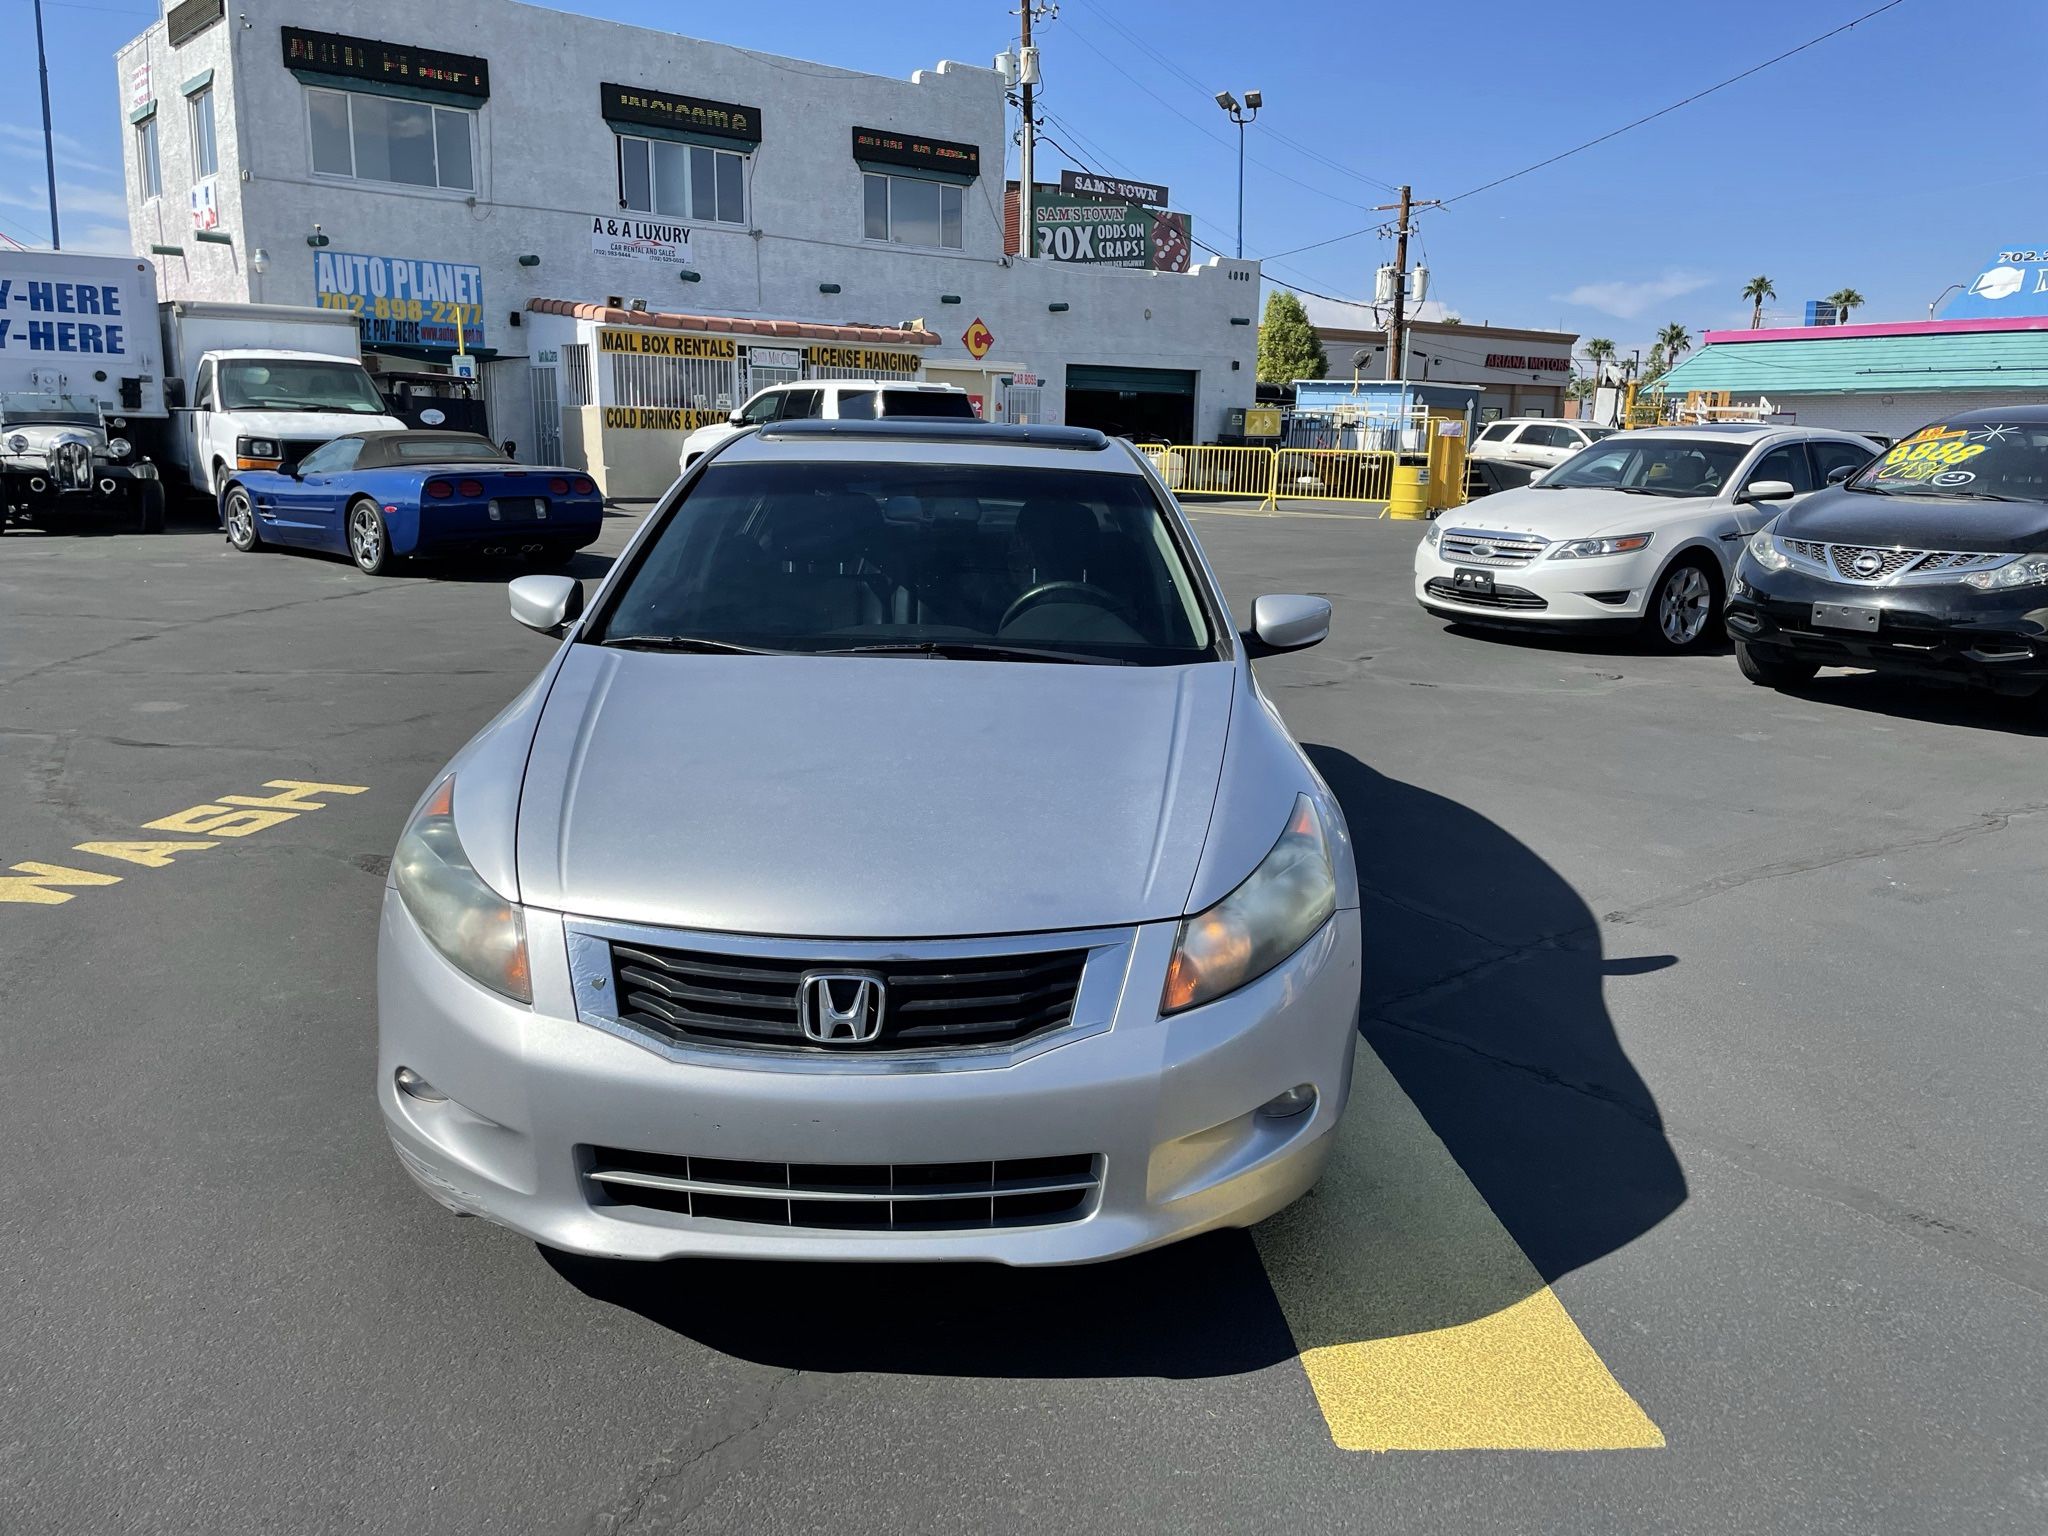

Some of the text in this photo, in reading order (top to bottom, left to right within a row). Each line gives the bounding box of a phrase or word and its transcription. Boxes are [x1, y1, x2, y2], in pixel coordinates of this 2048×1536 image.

[1074, 176, 1158, 201] SAM'S TOWN
[1037, 207, 1126, 222] SAM'S TOWN
[593, 217, 691, 244] A & A LUXURY
[1037, 226, 1095, 260] 20X
[1097, 224, 1145, 239] ODDS ON
[610, 243, 676, 257] CAR RENTAL AND SALES
[1098, 240, 1145, 258] CRAPS!
[318, 252, 480, 305] AUTO PLANET
[318, 291, 482, 326] 702-898-2277
[374, 318, 420, 343] PAY-HERE
[967, 323, 989, 356] C
[602, 332, 637, 351] MAIL
[641, 335, 670, 354] BOX
[674, 338, 735, 358] RENTALS
[810, 346, 919, 371] LICENSE HANGING
[1485, 354, 1570, 371] ARIANA MOTORS
[606, 408, 637, 429] COLD
[640, 409, 681, 430] DRINKS
[685, 408, 693, 430] &
